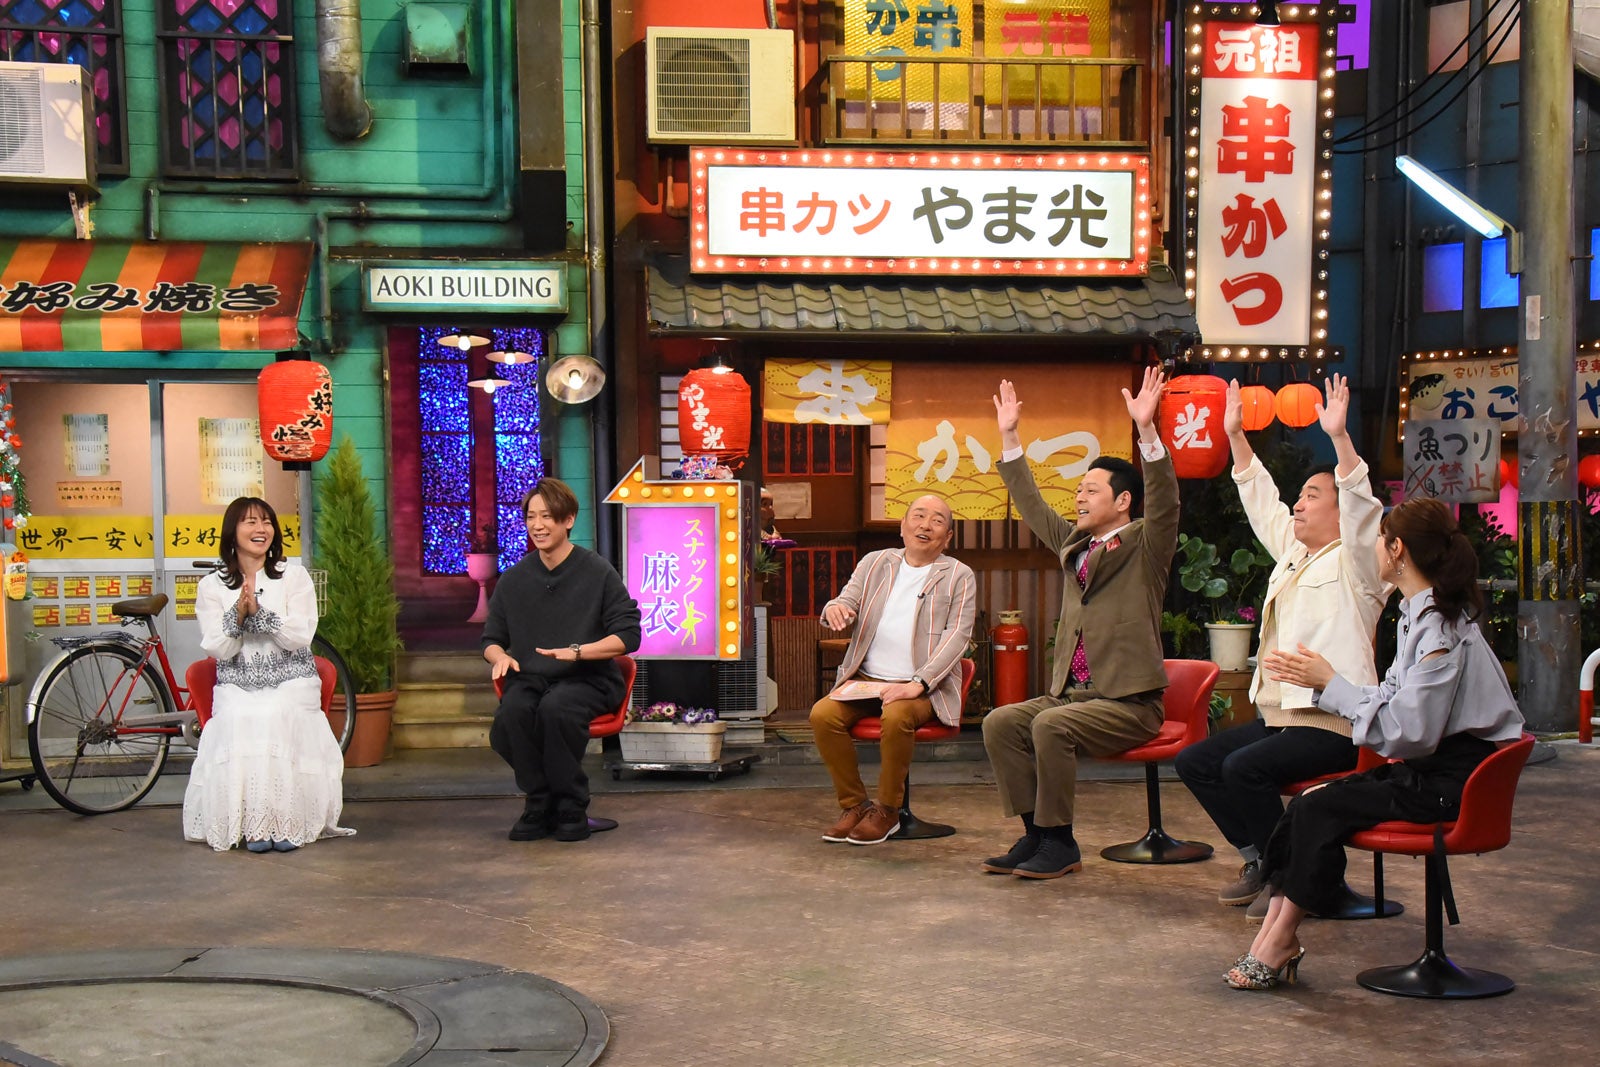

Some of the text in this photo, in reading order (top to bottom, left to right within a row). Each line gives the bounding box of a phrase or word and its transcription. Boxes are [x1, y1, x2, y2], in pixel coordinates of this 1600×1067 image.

[1001, 11, 1092, 56] 元祖
[1214, 28, 1301, 73] 元祖
[739, 184, 1109, 248] 串カツ やま光
[1217, 95, 1296, 326] 串かつ
[0, 282, 280, 312] 好み焼き
[376, 275, 552, 298] AOKI BUILDING
[681, 383, 726, 450] やま光
[1172, 402, 1213, 450] 光
[913, 419, 1101, 483] かつ
[1414, 426, 1492, 461] 魚つり
[1438, 460, 1492, 494] 禁止
[20, 526, 295, 552] 世界一安い お好き
[683, 519, 708, 596] スナック
[640, 551, 681, 637] 麻衣
